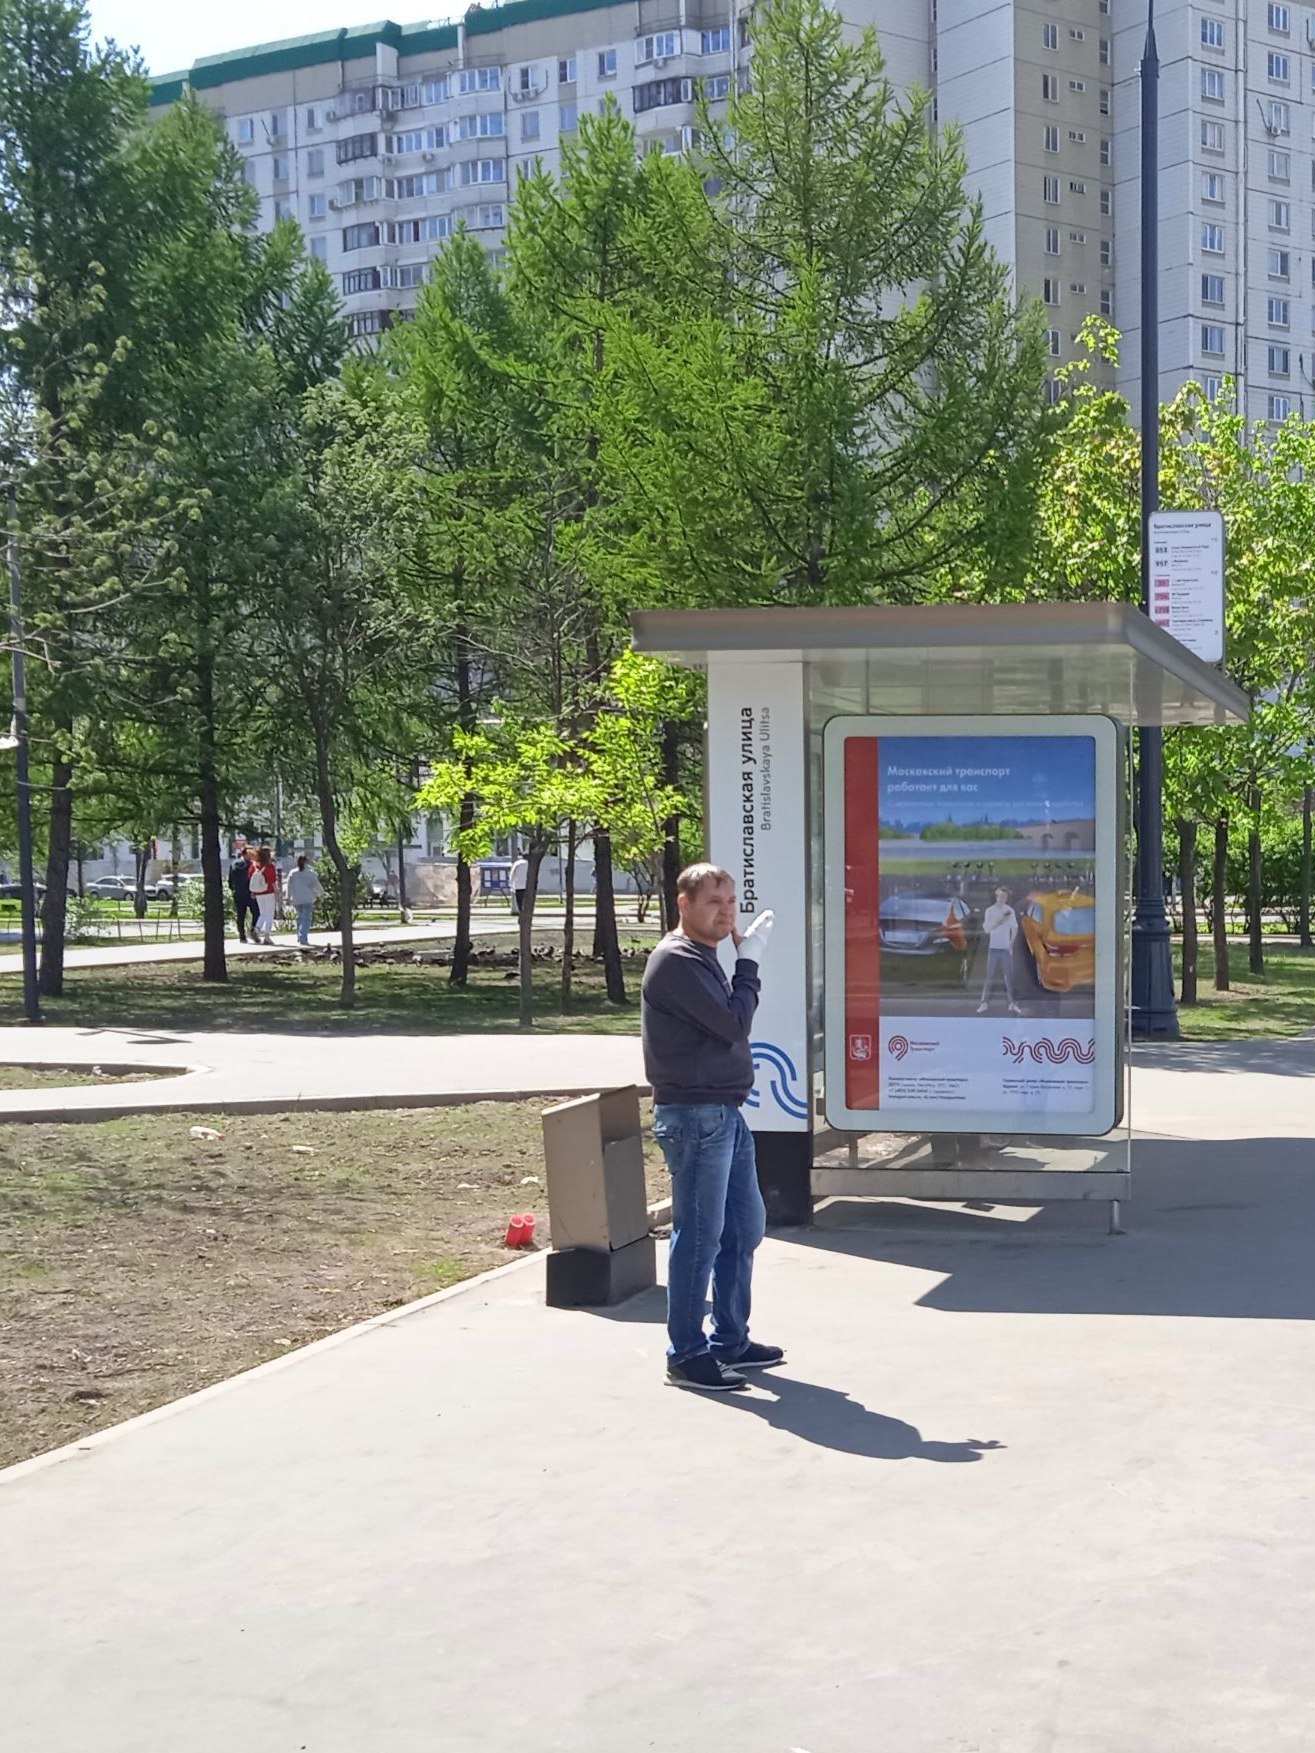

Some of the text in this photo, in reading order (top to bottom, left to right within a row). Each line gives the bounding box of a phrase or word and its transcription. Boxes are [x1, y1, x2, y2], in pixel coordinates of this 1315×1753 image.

[759, 706, 773, 831] Bratislavskaya Ulitsa
[887, 764, 1012, 779] Московский транспорт
[887, 781, 979, 794] работает для вас
[740, 706, 758, 914] Братиславская улица
